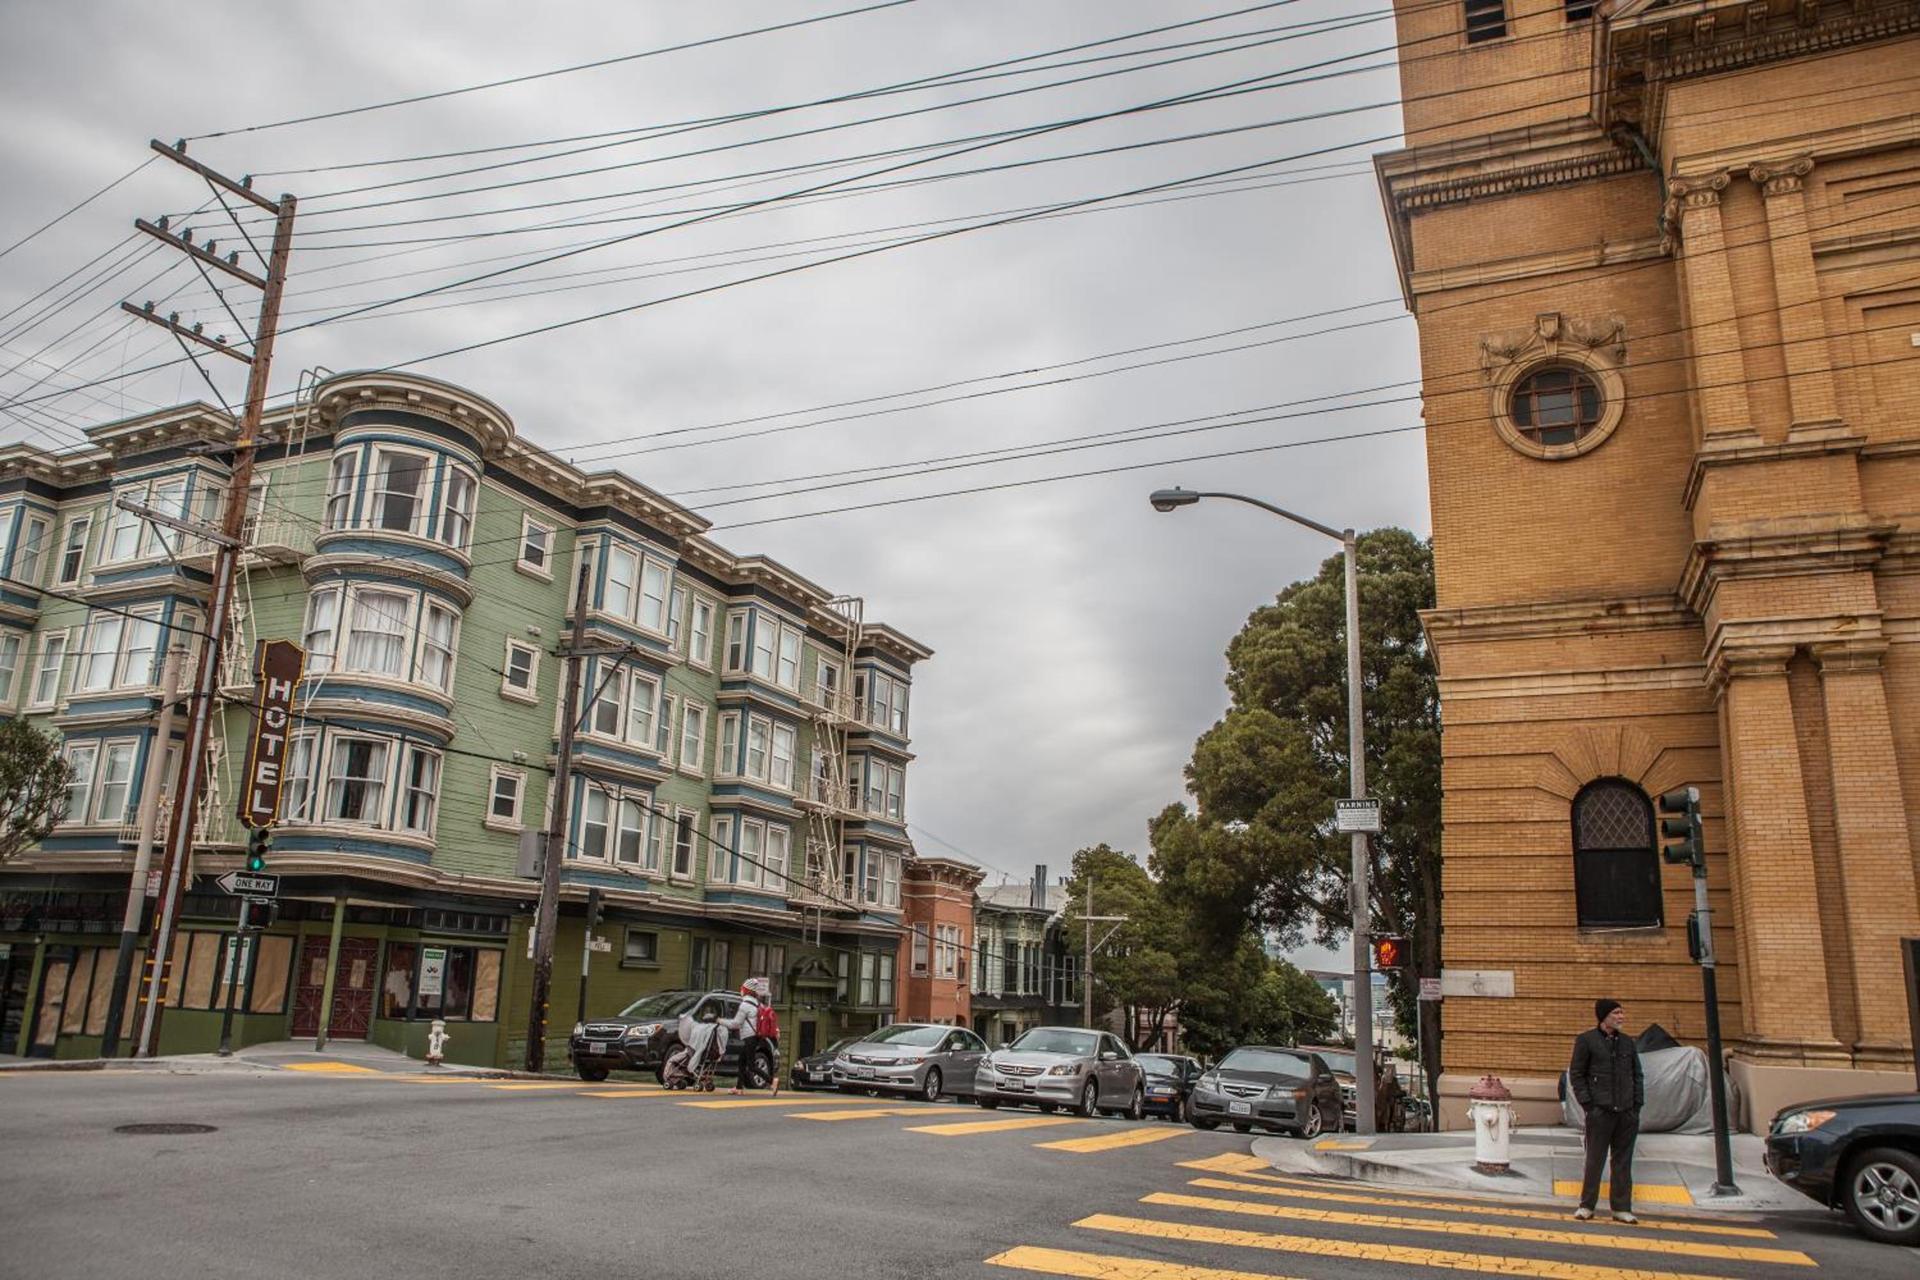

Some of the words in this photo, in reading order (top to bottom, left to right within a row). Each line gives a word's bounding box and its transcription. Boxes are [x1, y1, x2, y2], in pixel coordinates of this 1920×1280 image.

[252, 677, 291, 814] HOTEL
[235, 878, 253, 888] ONE
[255, 880, 273, 890] WAY
